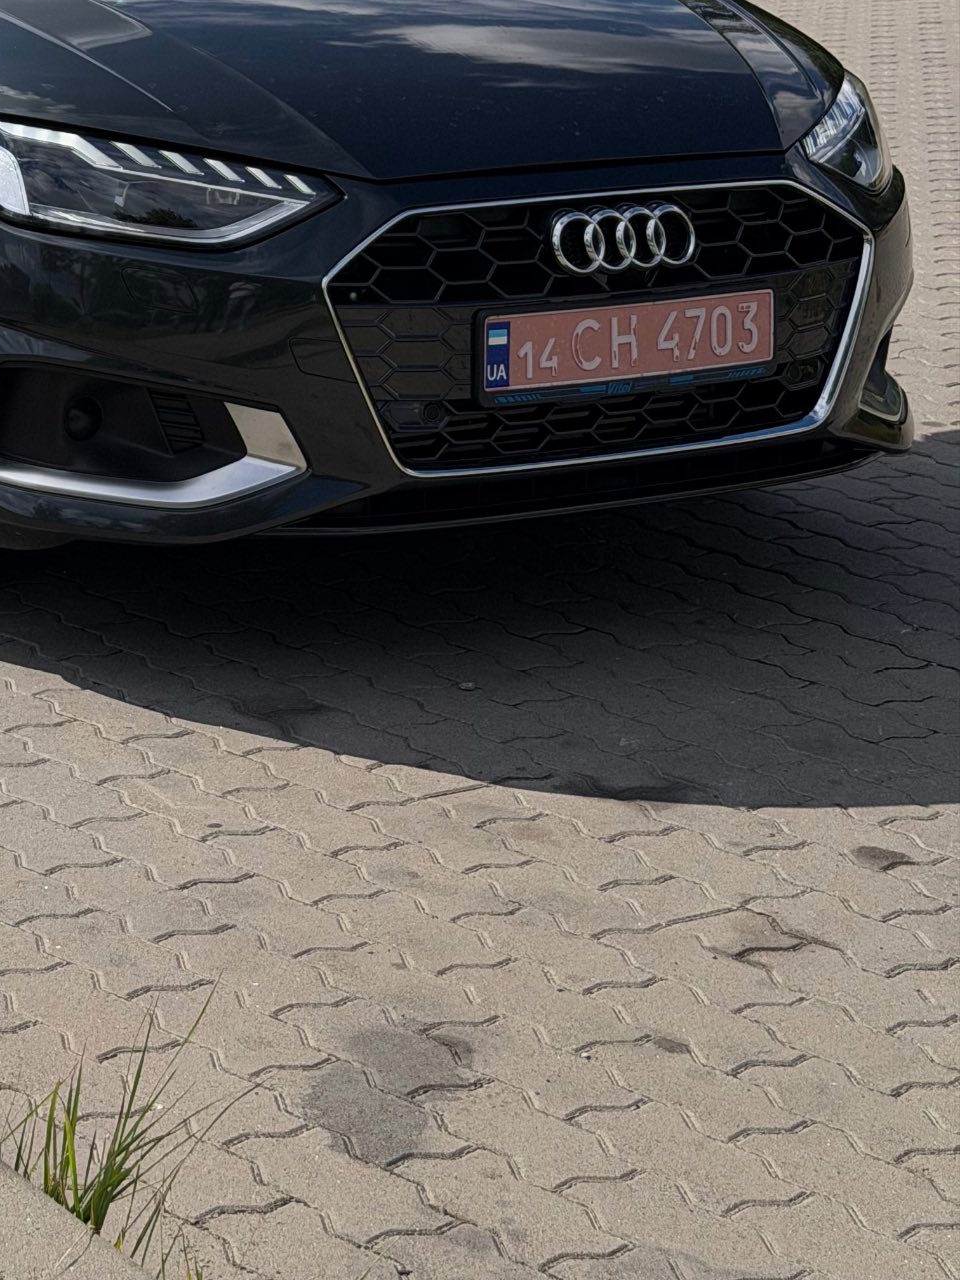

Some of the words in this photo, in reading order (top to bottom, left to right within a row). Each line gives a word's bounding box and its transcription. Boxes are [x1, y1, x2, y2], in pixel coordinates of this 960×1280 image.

[517, 337, 558, 379] 14
[571, 314, 638, 370] CH
[657, 301, 758, 362] 4703
[487, 363, 507, 381] UA
